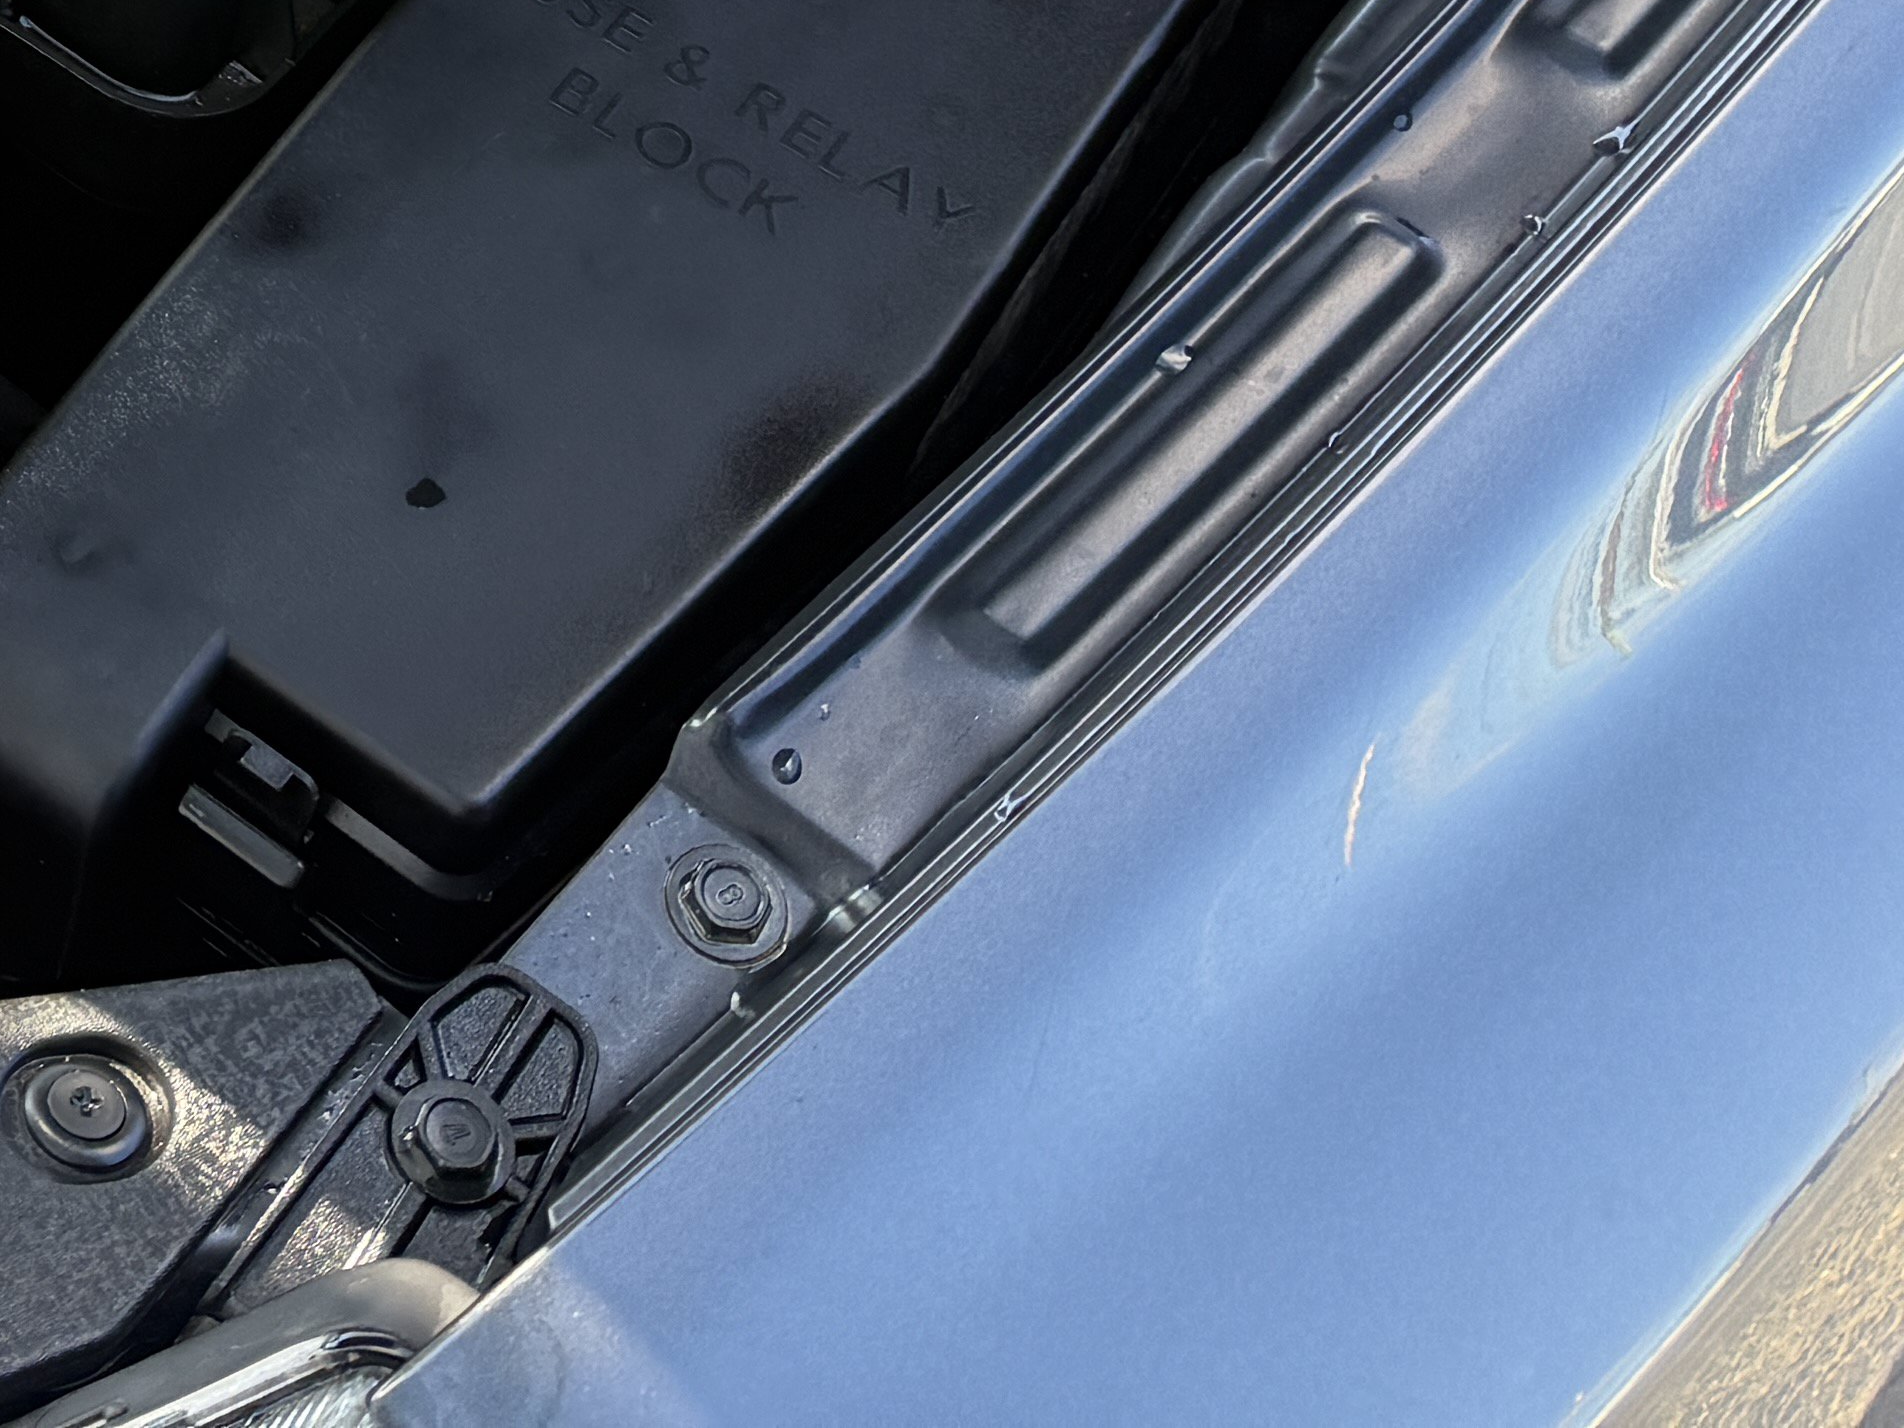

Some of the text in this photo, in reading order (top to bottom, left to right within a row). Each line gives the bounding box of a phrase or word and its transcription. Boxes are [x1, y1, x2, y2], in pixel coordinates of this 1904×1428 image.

[549, 67, 799, 236] BLOCK
[663, 45, 711, 90] &
[735, 82, 976, 230] RELAY
